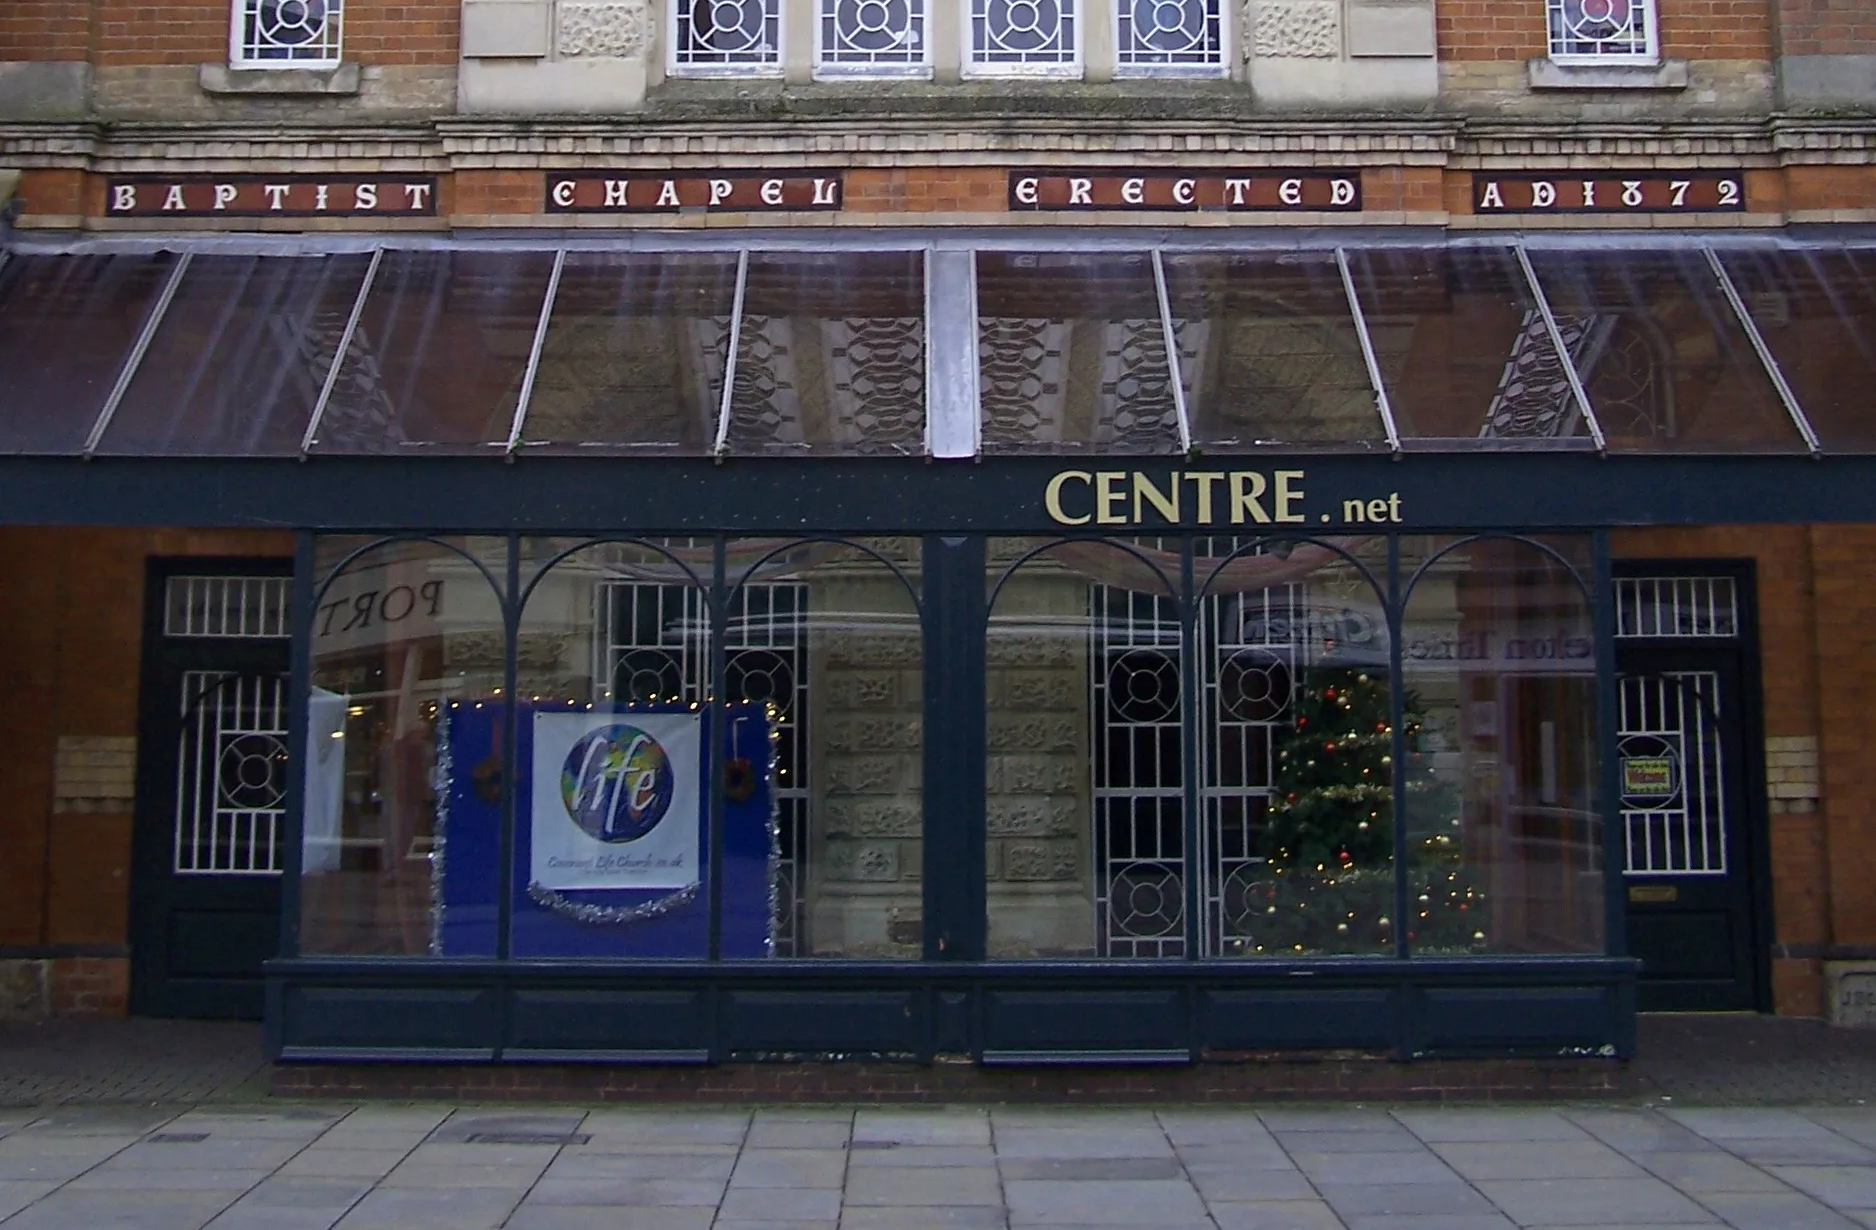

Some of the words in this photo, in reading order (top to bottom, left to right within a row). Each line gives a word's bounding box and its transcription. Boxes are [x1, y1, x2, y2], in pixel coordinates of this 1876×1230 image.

[113, 183, 430, 210] BAPTIST
[552, 178, 837, 207] CHAPEL
[1015, 177, 1355, 206] ERECTED
[1045, 470, 1306, 525] CENTRE
[571, 733, 658, 835] life
